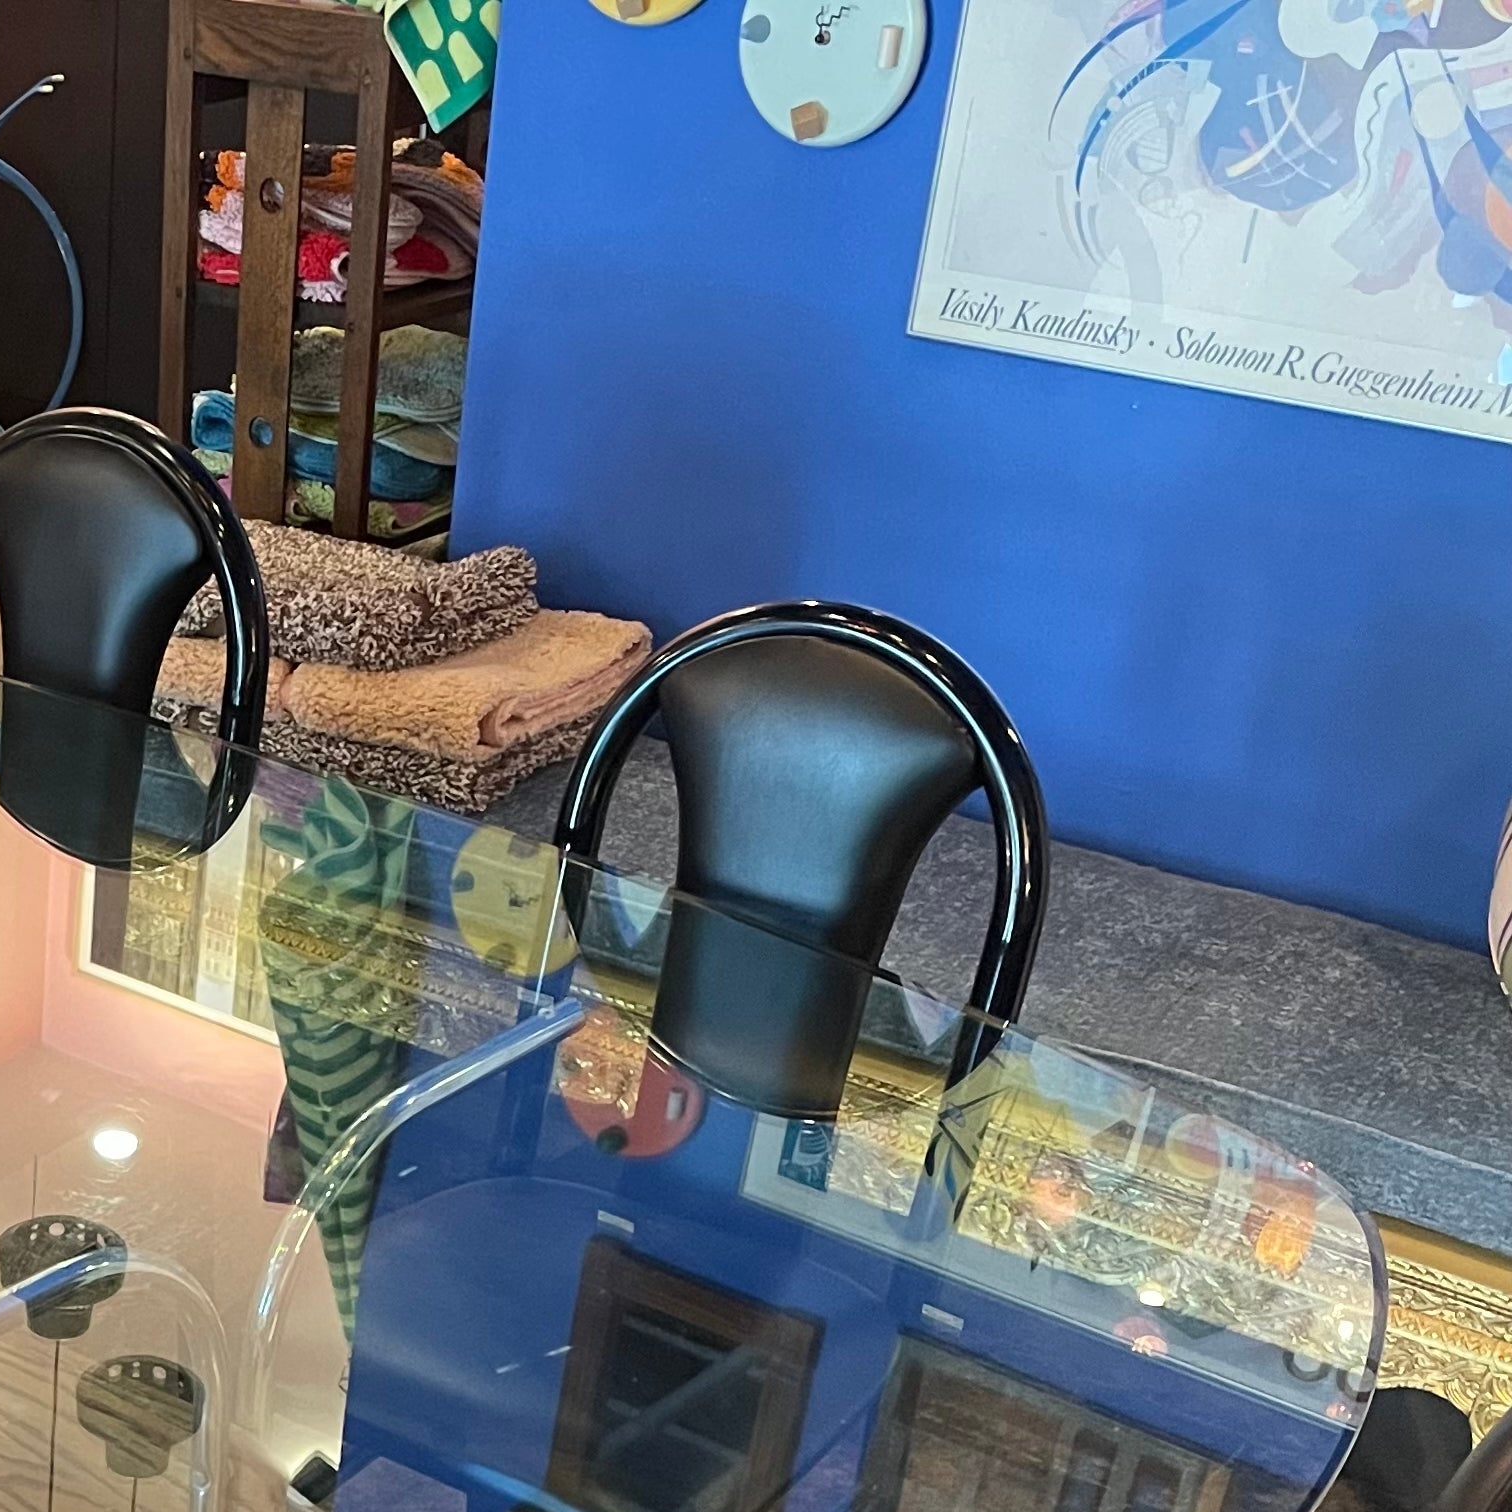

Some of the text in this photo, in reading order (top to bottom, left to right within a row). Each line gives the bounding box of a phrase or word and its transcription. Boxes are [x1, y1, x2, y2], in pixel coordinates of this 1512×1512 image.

[939, 287, 1004, 330] Vasily
[1010, 299, 1141, 354] Kandinsky
[1165, 326, 1276, 374] Solomon
[1311, 351, 1484, 410] Guggenheim
